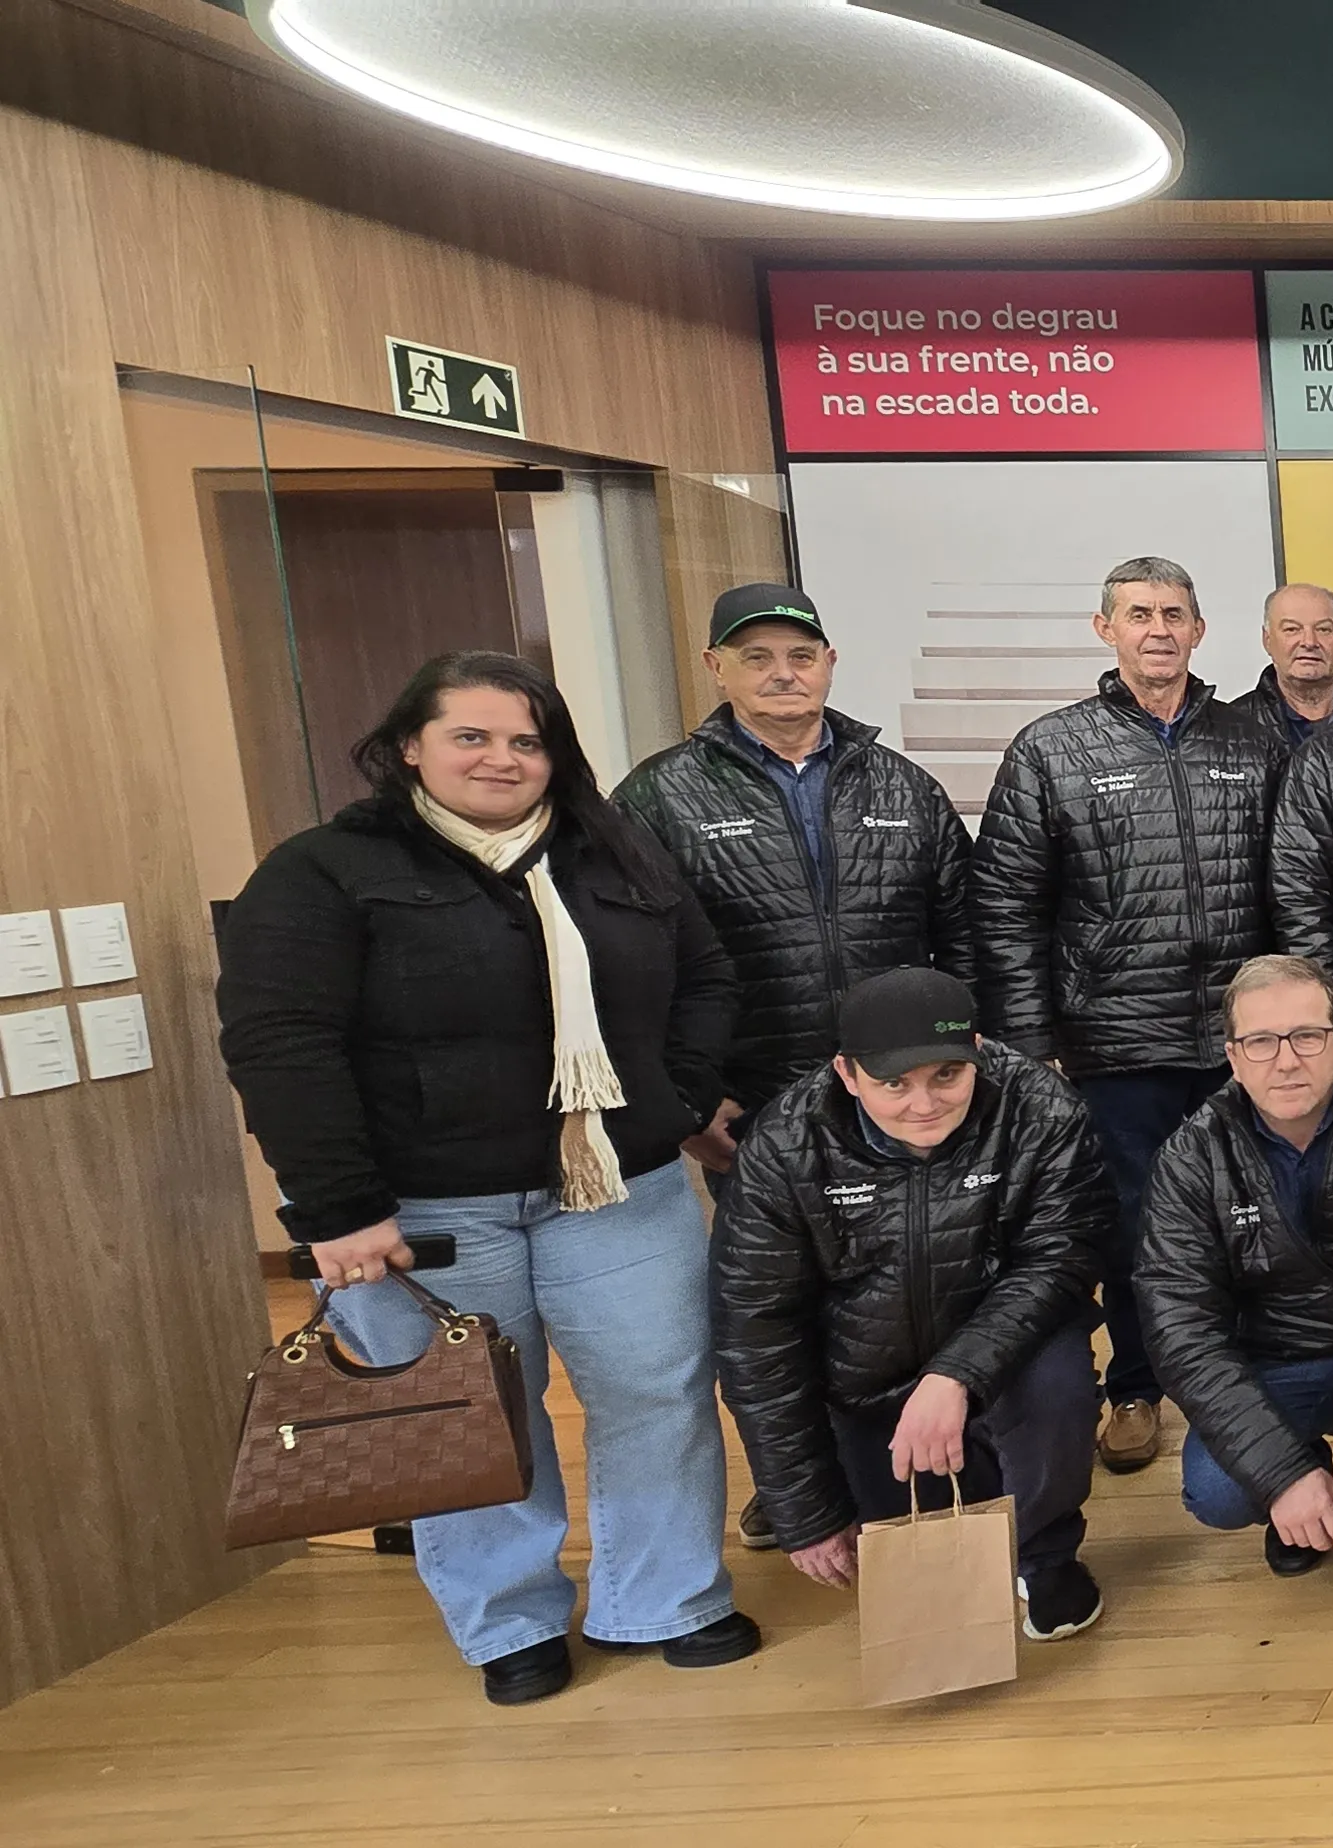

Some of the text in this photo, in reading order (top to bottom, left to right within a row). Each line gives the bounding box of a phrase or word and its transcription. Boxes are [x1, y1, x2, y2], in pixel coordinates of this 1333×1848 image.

[813, 302, 1118, 336] Foque no degrau
[1300, 303, 1316, 331] A
[818, 345, 1115, 377] à sua frente, não
[822, 387, 1099, 415] na escada toda.
